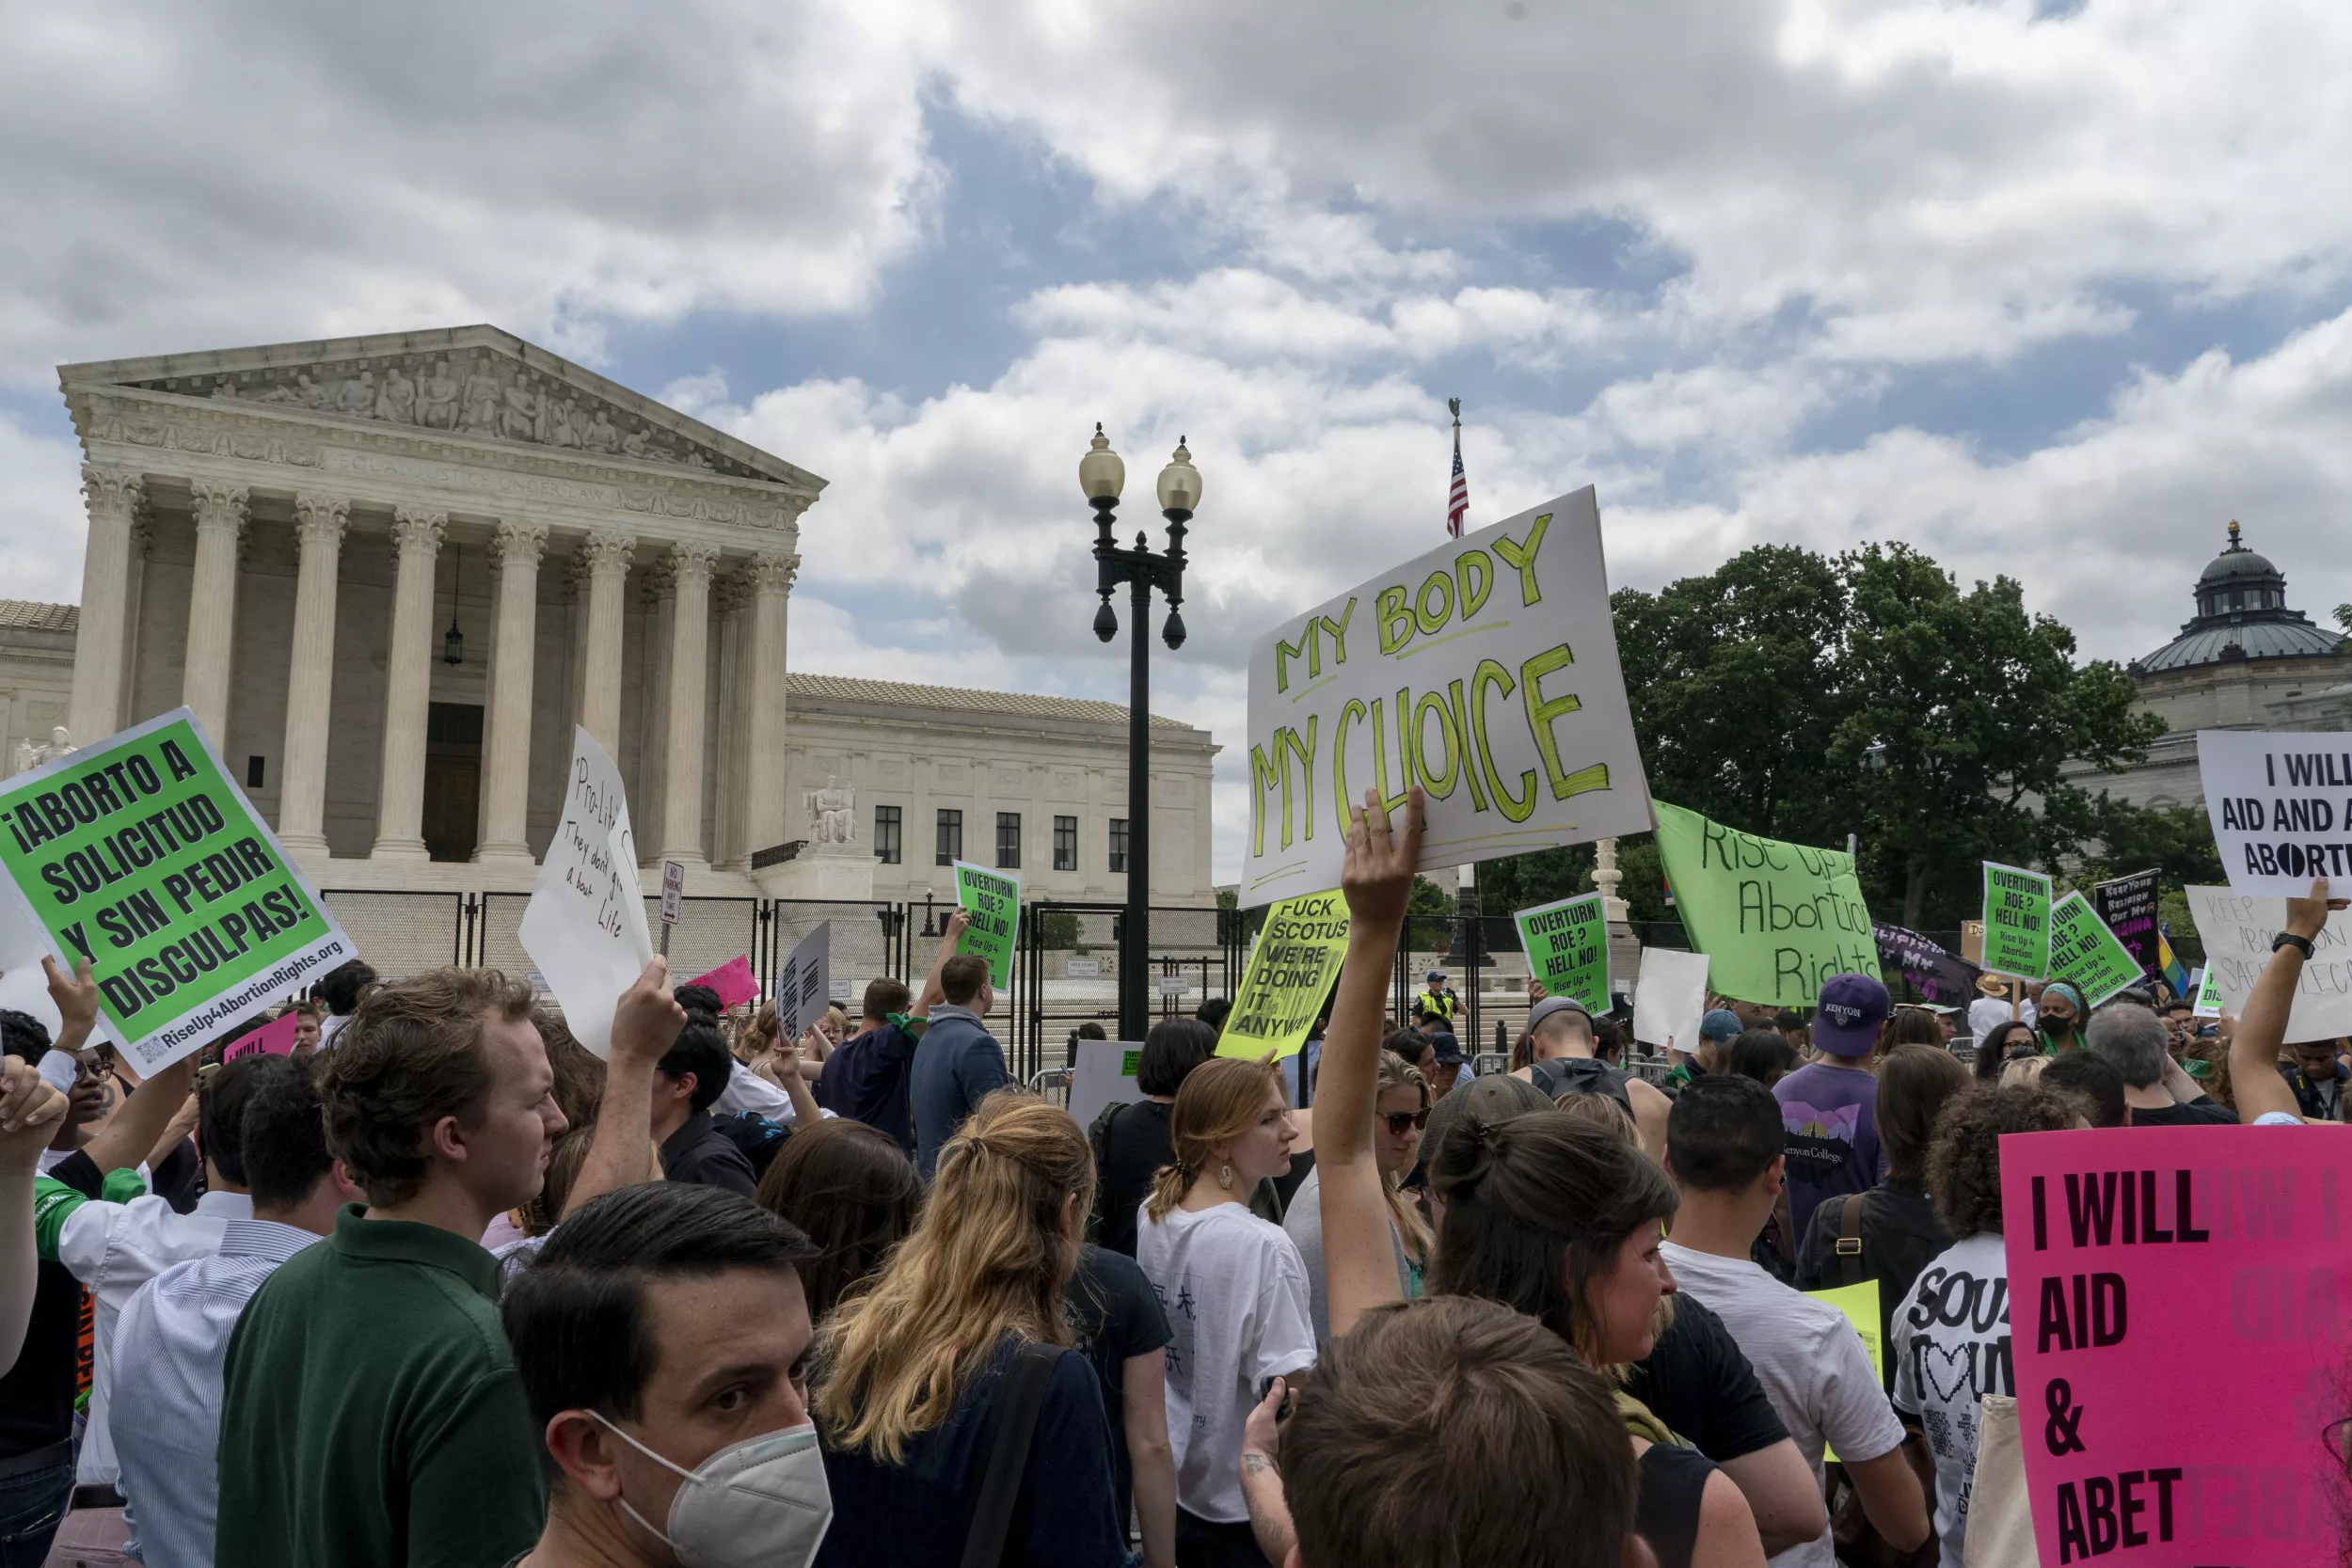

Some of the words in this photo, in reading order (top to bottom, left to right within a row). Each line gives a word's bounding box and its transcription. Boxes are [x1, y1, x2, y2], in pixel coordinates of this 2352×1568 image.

[341, 453, 409, 476] EQUAL
[413, 464, 490, 487] JUSTICE
[500, 475, 562, 498] UNDER
[568, 484, 605, 501] LAW
[1276, 596, 1358, 694] MY
[1375, 514, 1553, 656] BODY
[160, 739, 198, 783] A
[1250, 714, 1318, 858] MY
[1333, 642, 1613, 846] CHOICE
[2265, 753, 2275, 786] I
[2222, 798, 2265, 831] AID
[2273, 799, 2333, 832] AND
[40, 793, 226, 905] SOLICITUD
[564, 821, 589, 864] They
[670, 866, 677, 879] NO
[963, 870, 1013, 900] OVERTURN
[1994, 870, 2043, 896] OVERTURN
[61, 921, 98, 965] Y
[96, 888, 172, 948] SIN
[163, 836, 276, 915] PEDIR
[977, 892, 995, 911] ROE
[2005, 892, 2024, 910] ROE
[2206, 895, 2253, 923] KEEP
[597, 898, 622, 938] Life
[969, 909, 990, 933] HELL
[993, 918, 1009, 939] NO!
[1272, 919, 1349, 941] SCOTUS
[1528, 903, 1597, 936] OVERTURN
[1995, 908, 2019, 927] HELL
[2024, 914, 2041, 932] NO!
[99, 883, 310, 1019] DISCULPAS!
[967, 935, 982, 949] Rise
[983, 940, 993, 953] Up
[993, 942, 998, 955] 4
[1549, 930, 1576, 954] ROE
[2000, 931, 2016, 943] Rise
[2018, 934, 2027, 946] Up
[2001, 944, 2033, 959] Abortion
[2050, 947, 2081, 973] HELL
[2076, 932, 2103, 955] NO!
[1265, 945, 1328, 964] WE'RE
[1545, 953, 1575, 976] HELL
[1579, 945, 1597, 967] NO!
[1998, 957, 2036, 975] Rights.org
[1256, 968, 1319, 988] DOING
[1554, 978, 1571, 994] Rise
[1573, 974, 1584, 988] Up
[1585, 972, 1592, 981] 4
[2066, 966, 2087, 981] Rise
[2085, 959, 2099, 973] Up
[2078, 965, 2113, 990] Abortion
[161, 940, 343, 1050] RiseUp4AbortionRights.org
[1248, 992, 1271, 1010] IT
[1234, 1012, 1314, 1037] ANYWAY
[1825, 1003, 1861, 1018] KENYON
[1783, 1144, 1810, 1158] Kenyon
[1810, 1147, 1842, 1164] College
[2031, 1176, 2047, 1251] I
[2064, 1169, 2209, 1249] WILL
[2037, 1272, 2127, 1354] AID
[2045, 1378, 2086, 1457] &
[2057, 1467, 2183, 1566] ABET
